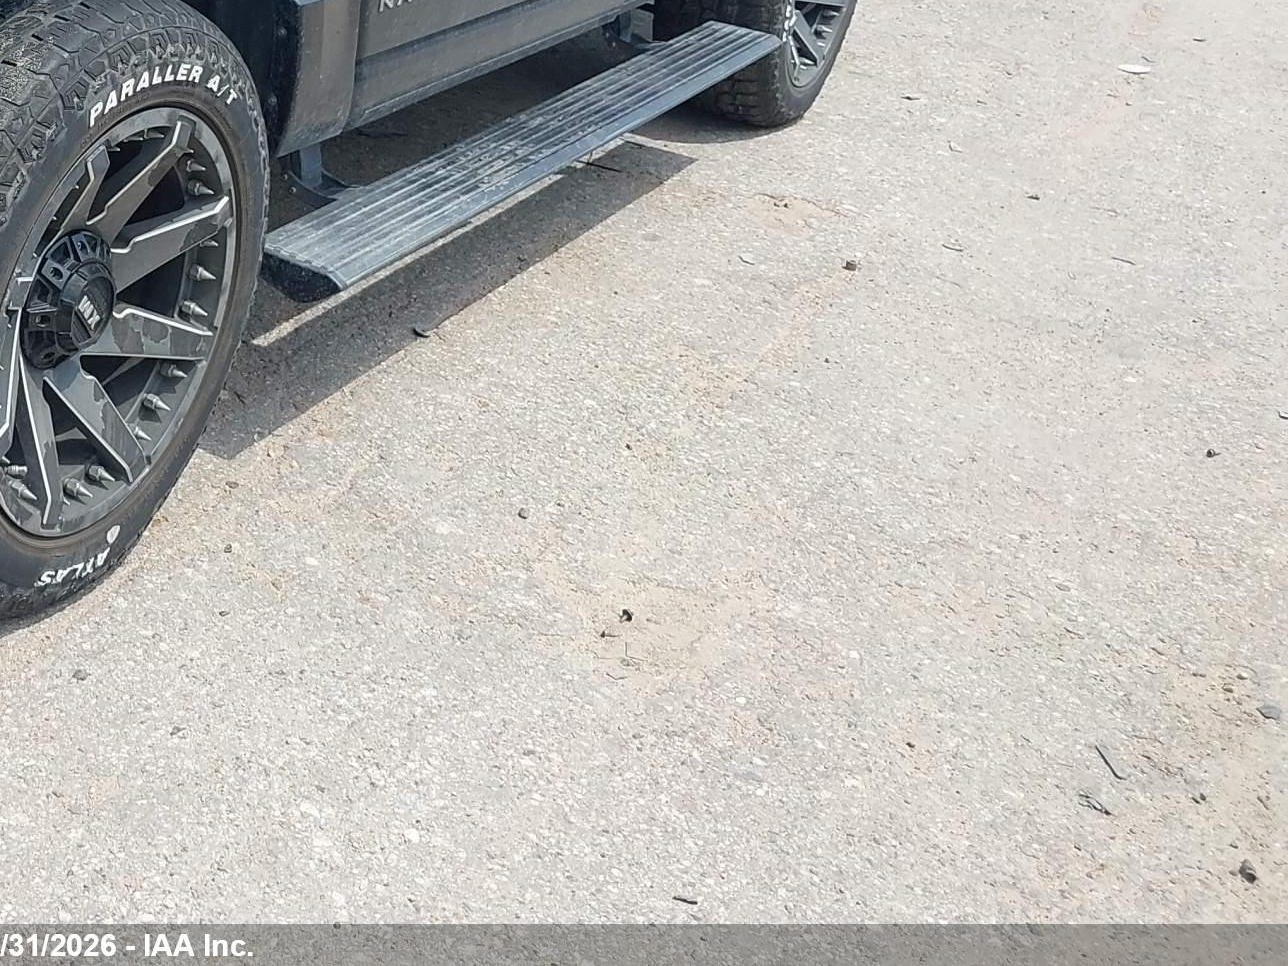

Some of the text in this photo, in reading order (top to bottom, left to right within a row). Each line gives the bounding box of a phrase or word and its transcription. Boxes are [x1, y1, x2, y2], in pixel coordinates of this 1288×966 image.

[89, 63, 204, 128] PARALLER
[206, 74, 238, 106] A/T
[34, 547, 111, 587] ATLAS
